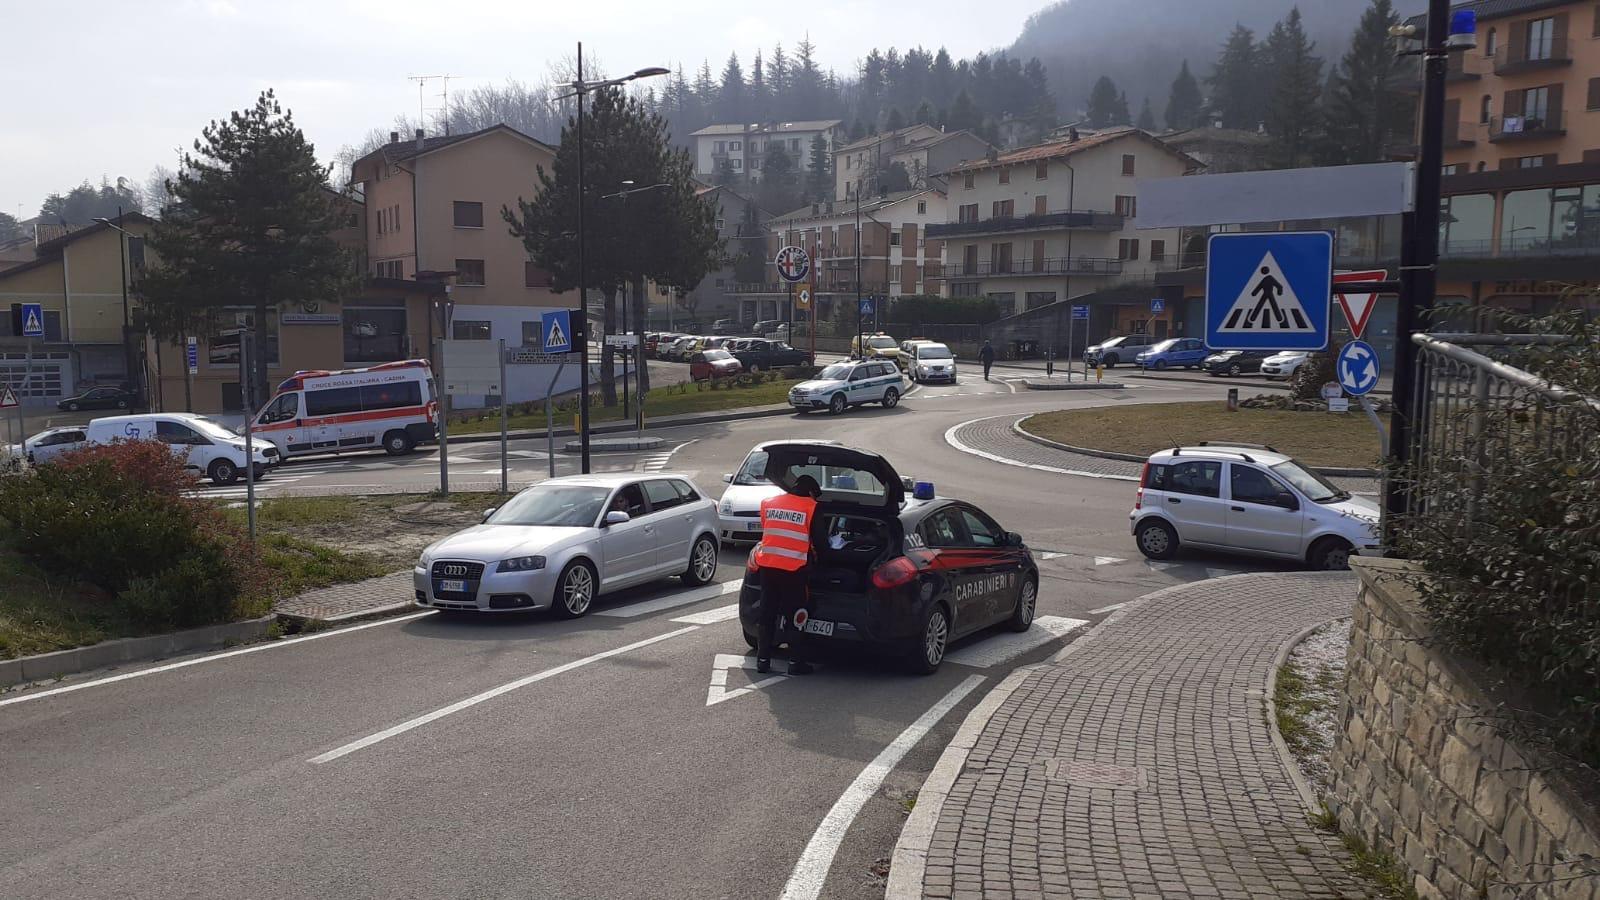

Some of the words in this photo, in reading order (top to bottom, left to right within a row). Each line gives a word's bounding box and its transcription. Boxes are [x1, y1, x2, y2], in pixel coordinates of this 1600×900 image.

[354, 377, 380, 385] ITALIANA
[765, 509, 804, 524] CARABINIERI
[905, 533, 925, 548] 112
[956, 573, 1008, 601] CARABINIERI
